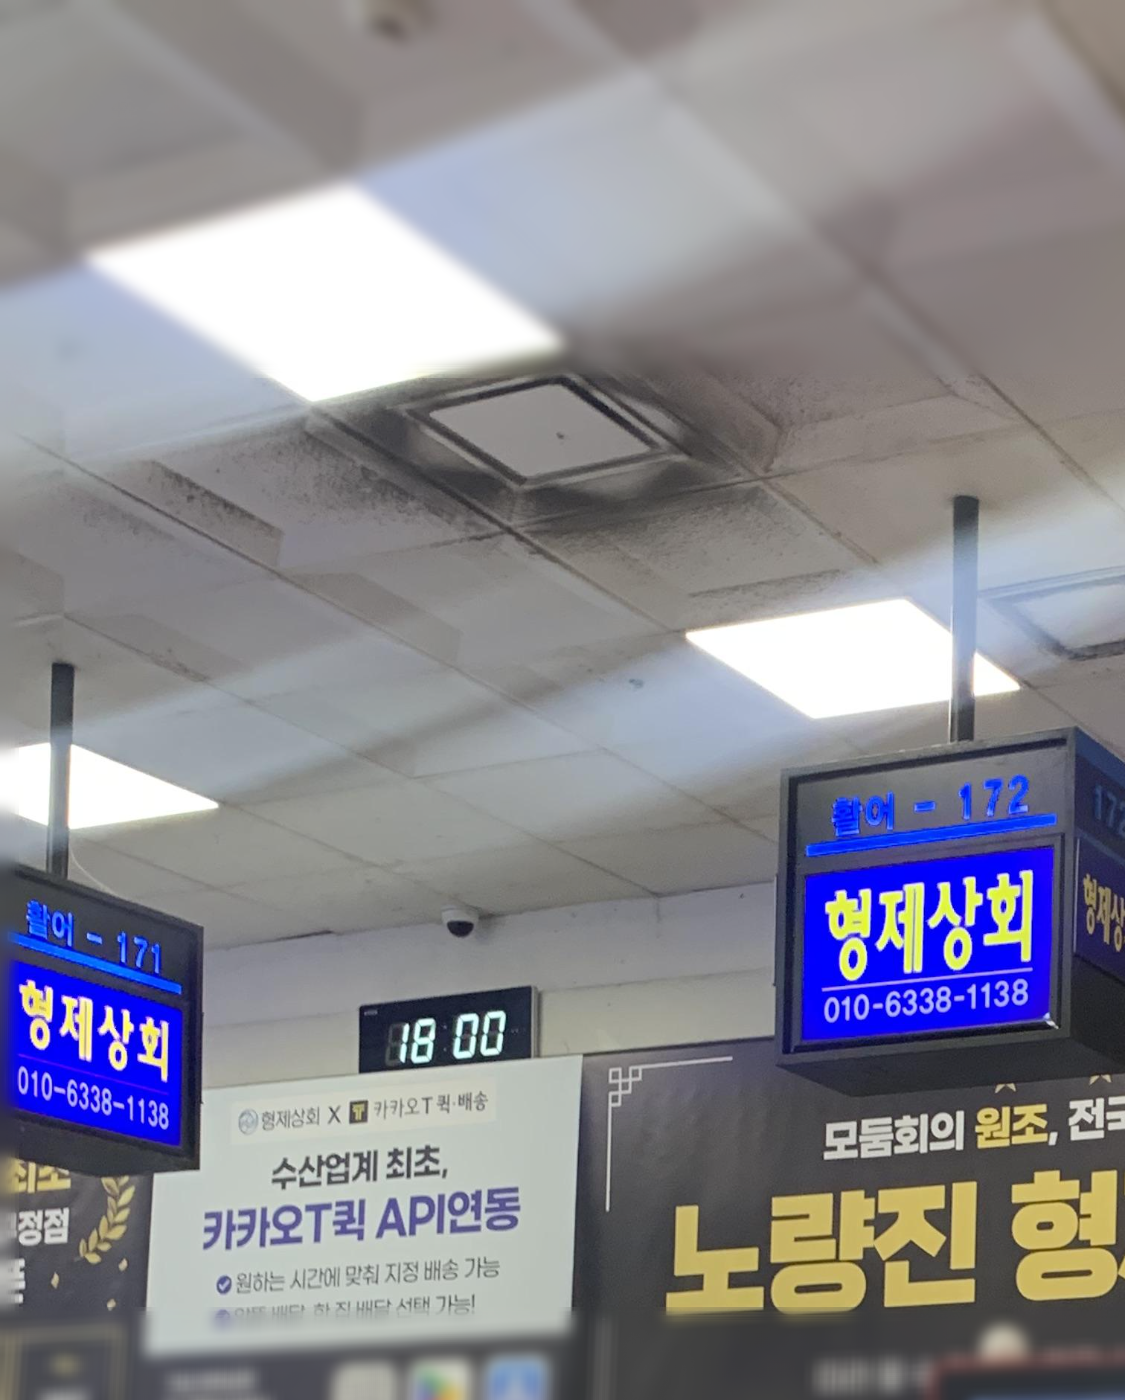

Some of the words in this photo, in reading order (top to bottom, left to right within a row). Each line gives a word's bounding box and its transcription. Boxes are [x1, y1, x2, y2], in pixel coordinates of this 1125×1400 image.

[831, 791, 895, 837] 활어
[959, 774, 1030, 820] 172
[26, 899, 74, 947] 활어
[117, 931, 161, 974] 171
[825, 870, 1033, 981] 형제상회
[19, 979, 169, 1082] 형제상회
[823, 979, 1029, 1023] 010-6338-1138
[17, 1066, 169, 1130] 010-6338-1138
[261, 1106, 320, 1131] 형제상회
[823, 1110, 965, 1160] 모둠회의
[975, 1103, 1059, 1149] 원조,
[271, 1149, 378, 1190] 수산업계
[386, 1144, 448, 1180] 최초,
[203, 1198, 366, 1251] 카카오T퀵
[376, 1187, 521, 1239] API연동
[665, 1181, 977, 1316] 노량진
[236, 1271, 286, 1295] 원하는
[289, 1266, 340, 1290] 시간에
[345, 1264, 379, 1287] 맞춰
[384, 1262, 420, 1284] 지정
[424, 1259, 459, 1281] 배송
[464, 1256, 501, 1279] 가능
